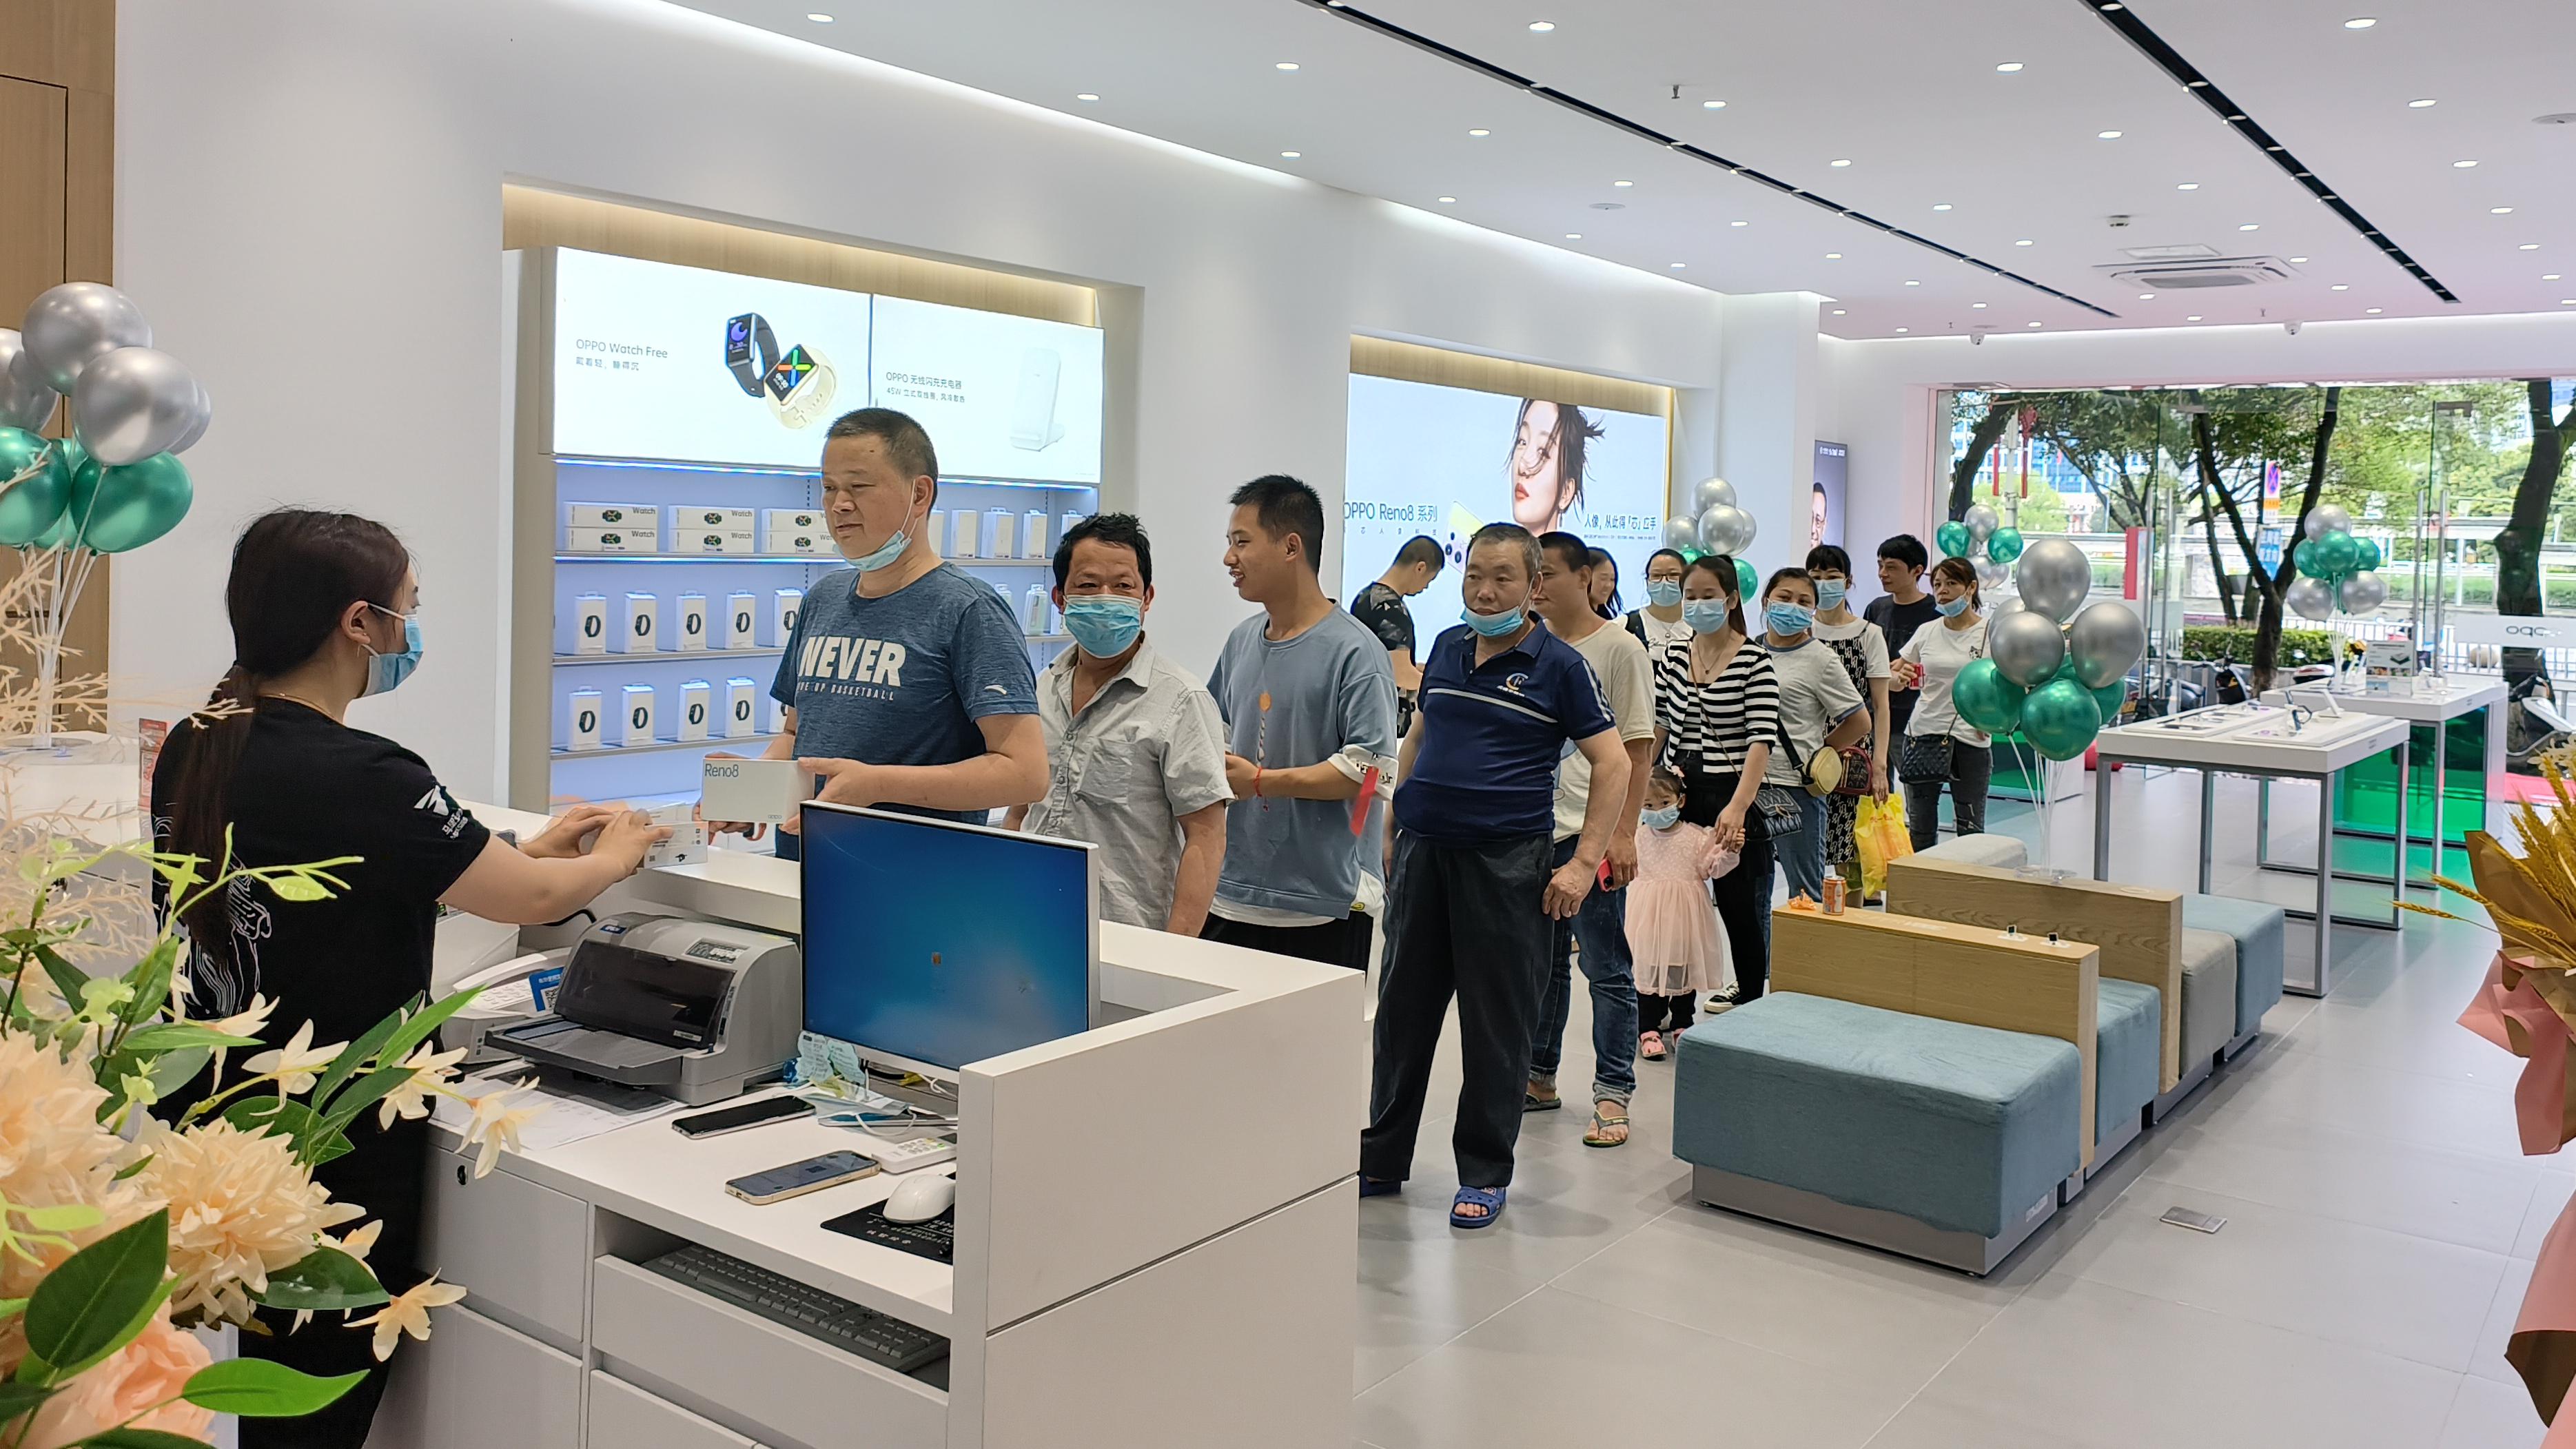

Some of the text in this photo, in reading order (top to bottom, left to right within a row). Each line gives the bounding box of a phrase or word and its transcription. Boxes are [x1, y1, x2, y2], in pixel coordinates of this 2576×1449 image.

[576, 338, 668, 358] OPPO Watch Free
[886, 371, 908, 382] OPPO
[1343, 502, 1438, 522] OPPO Reno8 系列
[798, 636, 906, 687] NEVER
[830, 684, 894, 701] BASKETBALL
[704, 763, 739, 778] Reno8
